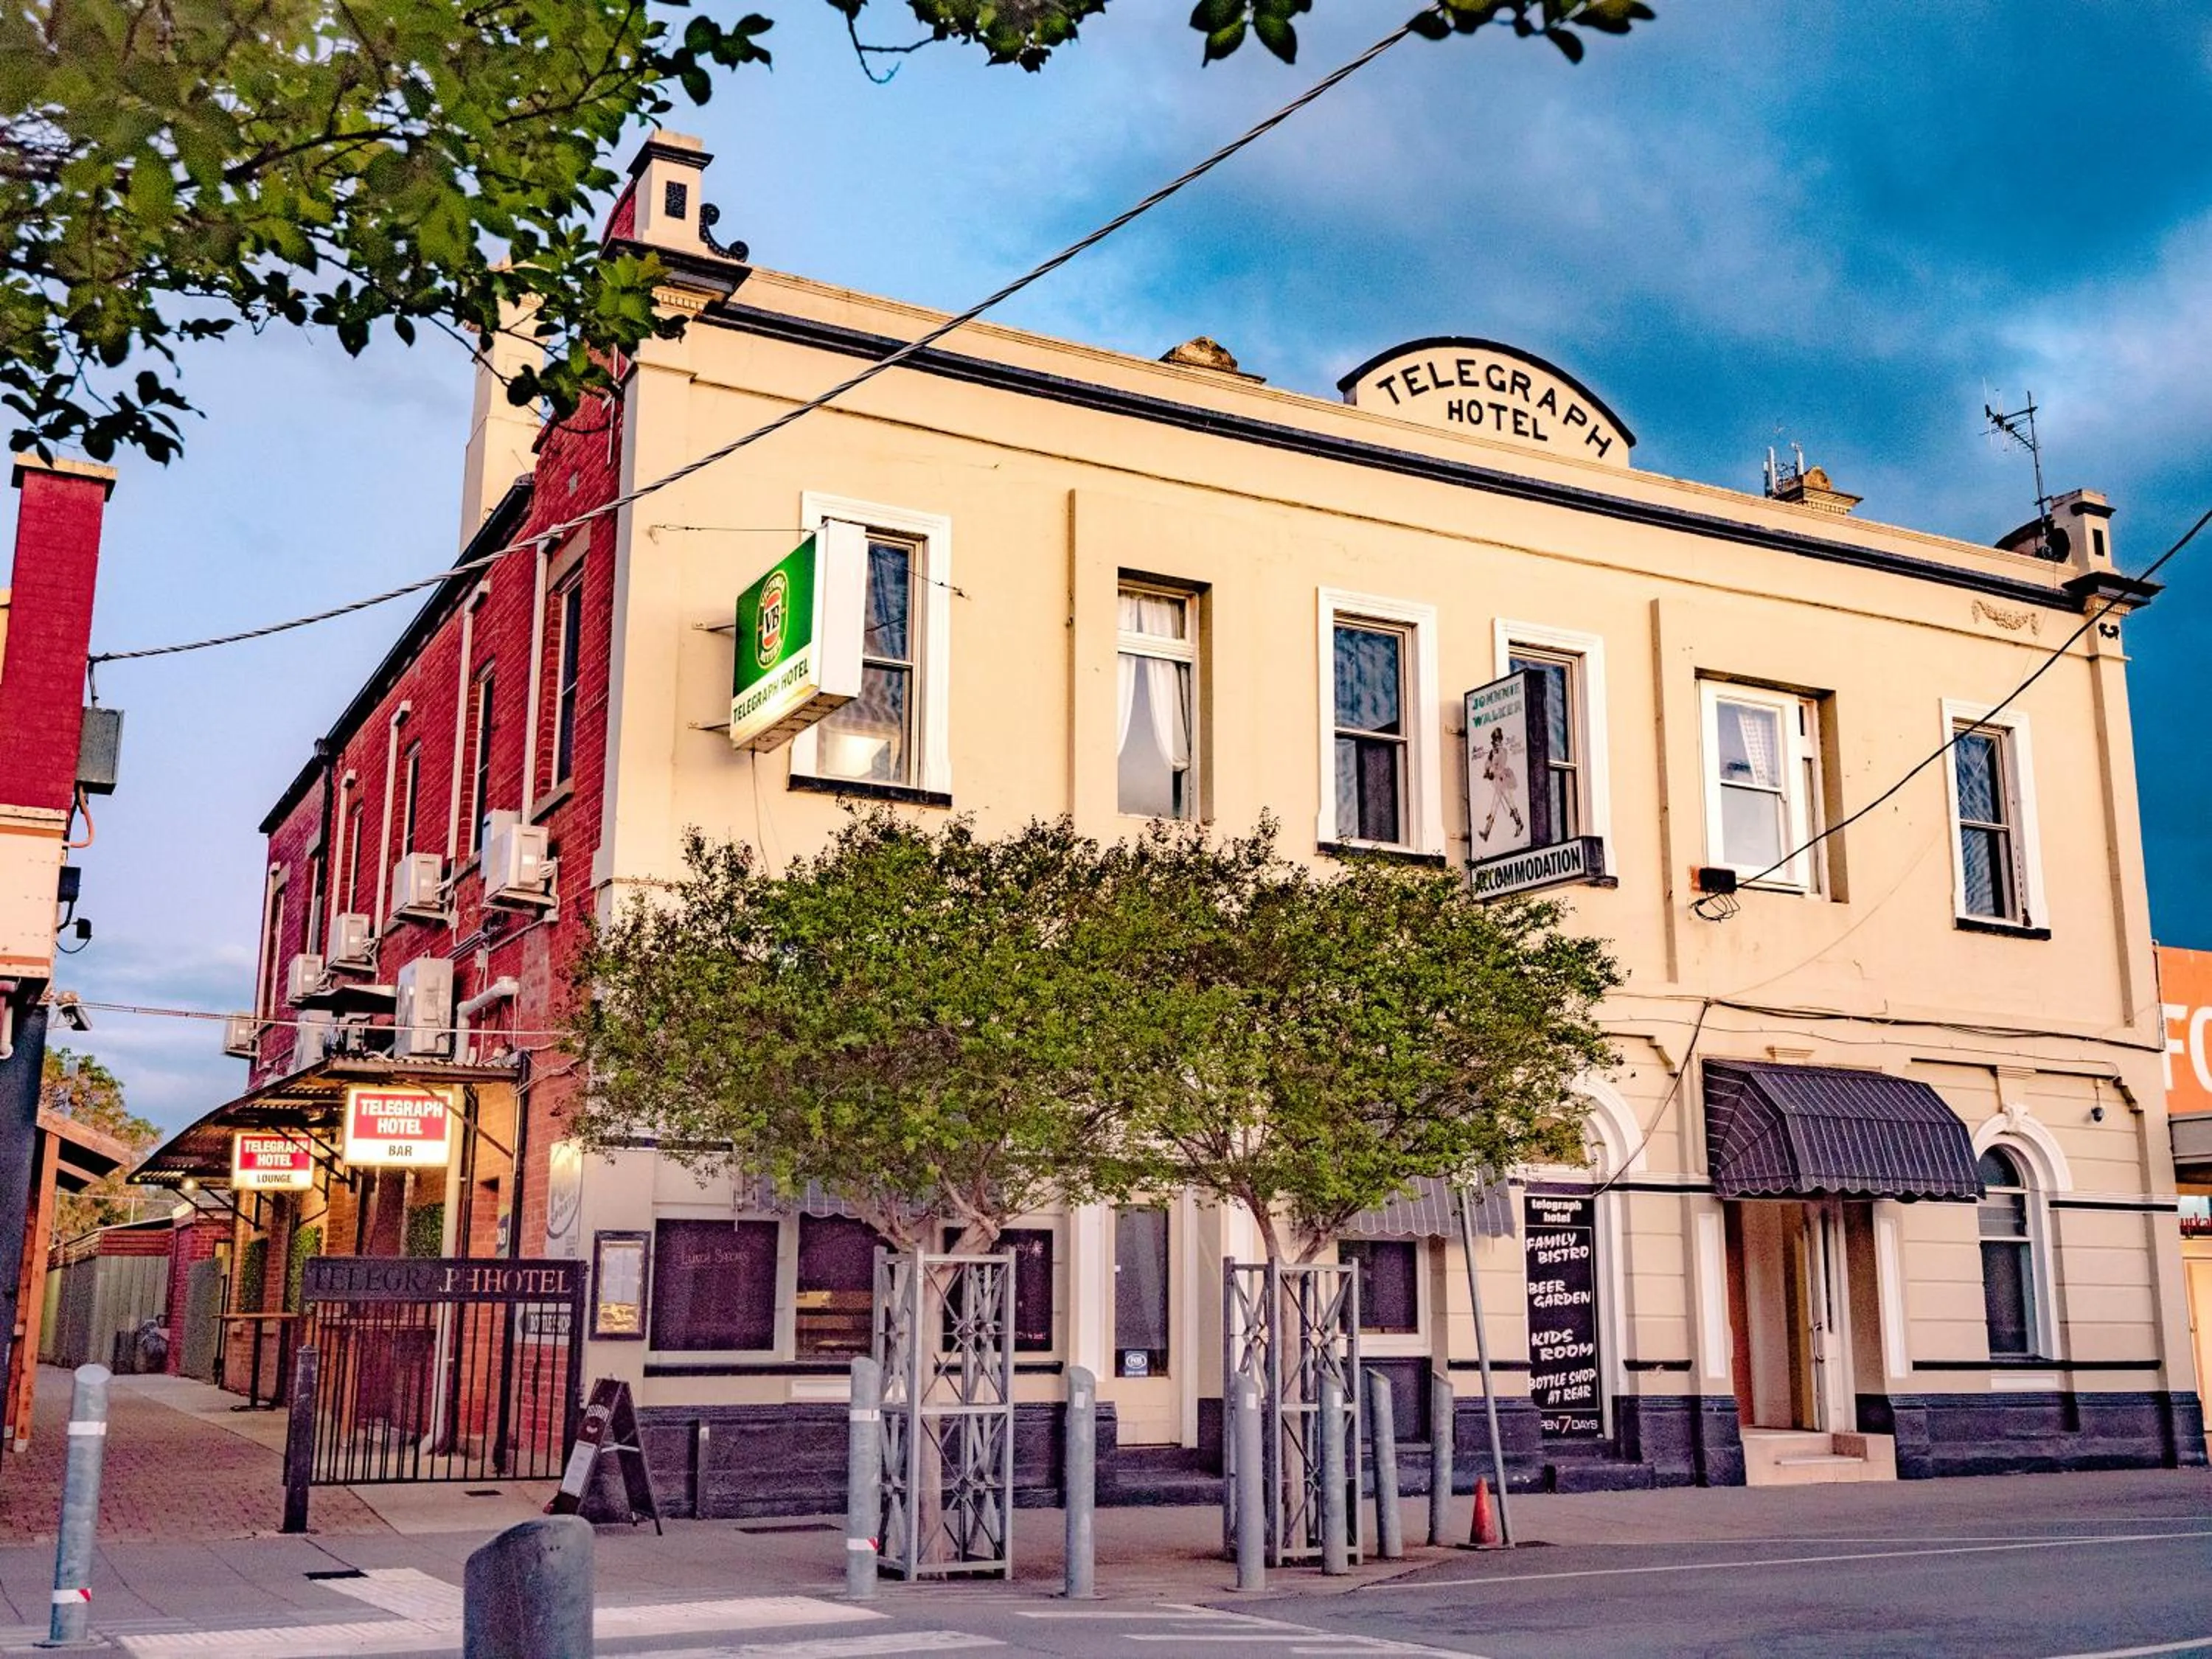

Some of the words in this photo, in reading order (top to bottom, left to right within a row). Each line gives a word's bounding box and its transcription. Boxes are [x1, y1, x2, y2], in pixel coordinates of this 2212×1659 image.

[1376, 358, 1613, 458] TELEGRAPH
[1447, 399, 1548, 441] HOTEL
[764, 605, 779, 633] VB
[734, 678, 779, 724] TELEGRAPH
[781, 657, 809, 690] HOTEL
[1472, 683, 1520, 710] JOHNNIE
[1472, 700, 1523, 728] WALKER
[360, 1099, 443, 1118] TELEGRAPH
[377, 1117, 423, 1135] HOTEL
[244, 1140, 308, 1154] TELEGRAPH
[389, 1144, 413, 1157] BAR
[257, 1153, 293, 1167] HOTEL
[257, 1174, 292, 1183] LOUNGE
[1531, 1199, 1582, 1211] telegraph
[1543, 1211, 1571, 1222] hotel
[1526, 1232, 1577, 1252] FAMILY
[1537, 1245, 1589, 1265] BISTRO
[481, 1267, 572, 1293] HOTEL
[1528, 1280, 1565, 1295] BEER
[1533, 1290, 1591, 1308] GARDEN
[530, 1315, 552, 1334] BOTLE
[1531, 1328, 1573, 1347] KIDS
[1540, 1343, 1593, 1362] ROOM
[1528, 1372, 1567, 1391] BOTTLE
[1568, 1368, 1596, 1385] SHOP
[1548, 1390, 1561, 1405] AT
[1563, 1385, 1592, 1401] REAR
[1540, 1419, 1559, 1430] PEN
[1558, 1415, 1571, 1434] 7
[1571, 1419, 1599, 1430] DAYS
